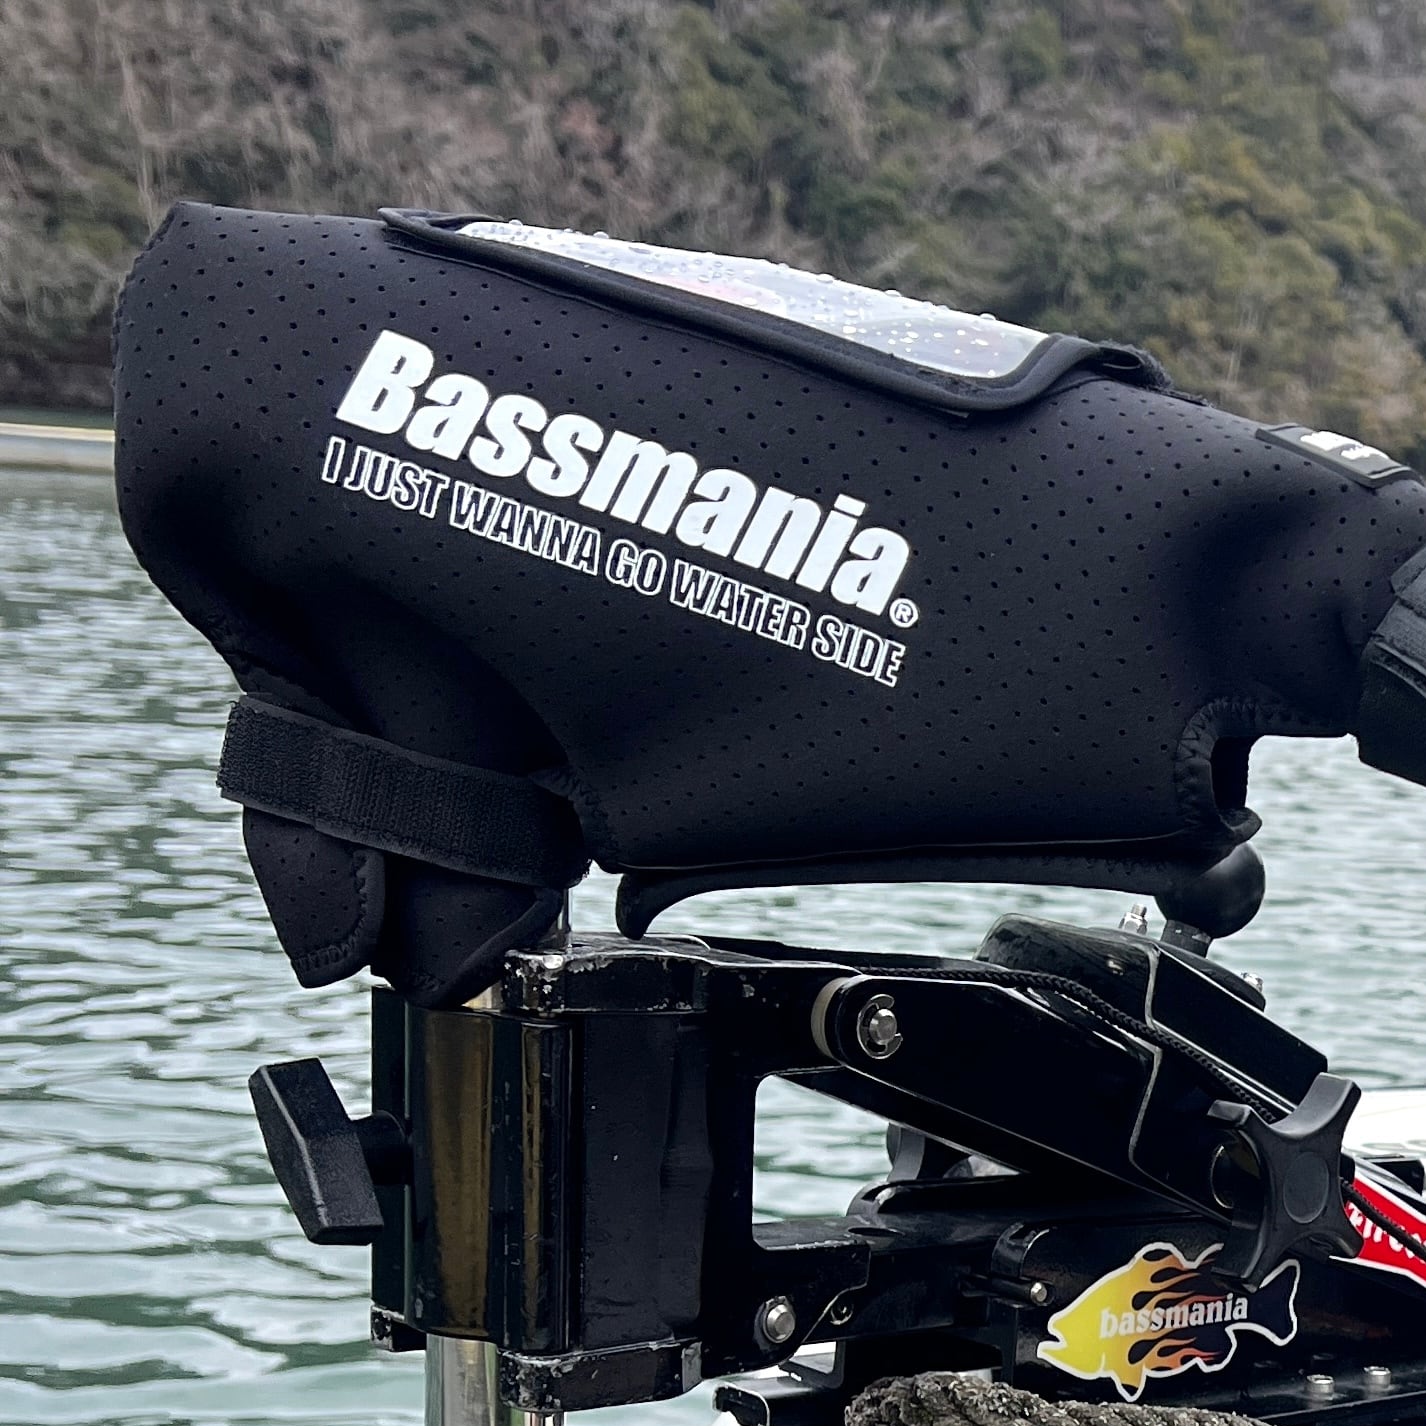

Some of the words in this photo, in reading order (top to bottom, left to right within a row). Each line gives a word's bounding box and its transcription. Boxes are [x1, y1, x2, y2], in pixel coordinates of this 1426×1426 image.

[321, 436, 346, 484] I
[344, 442, 451, 520] JUST
[449, 482, 602, 577] WANNA
[605, 538, 667, 597] GO
[670, 560, 812, 651] WATER
[811, 614, 906, 688] SIDE
[1099, 1293, 1249, 1339] bassmania
